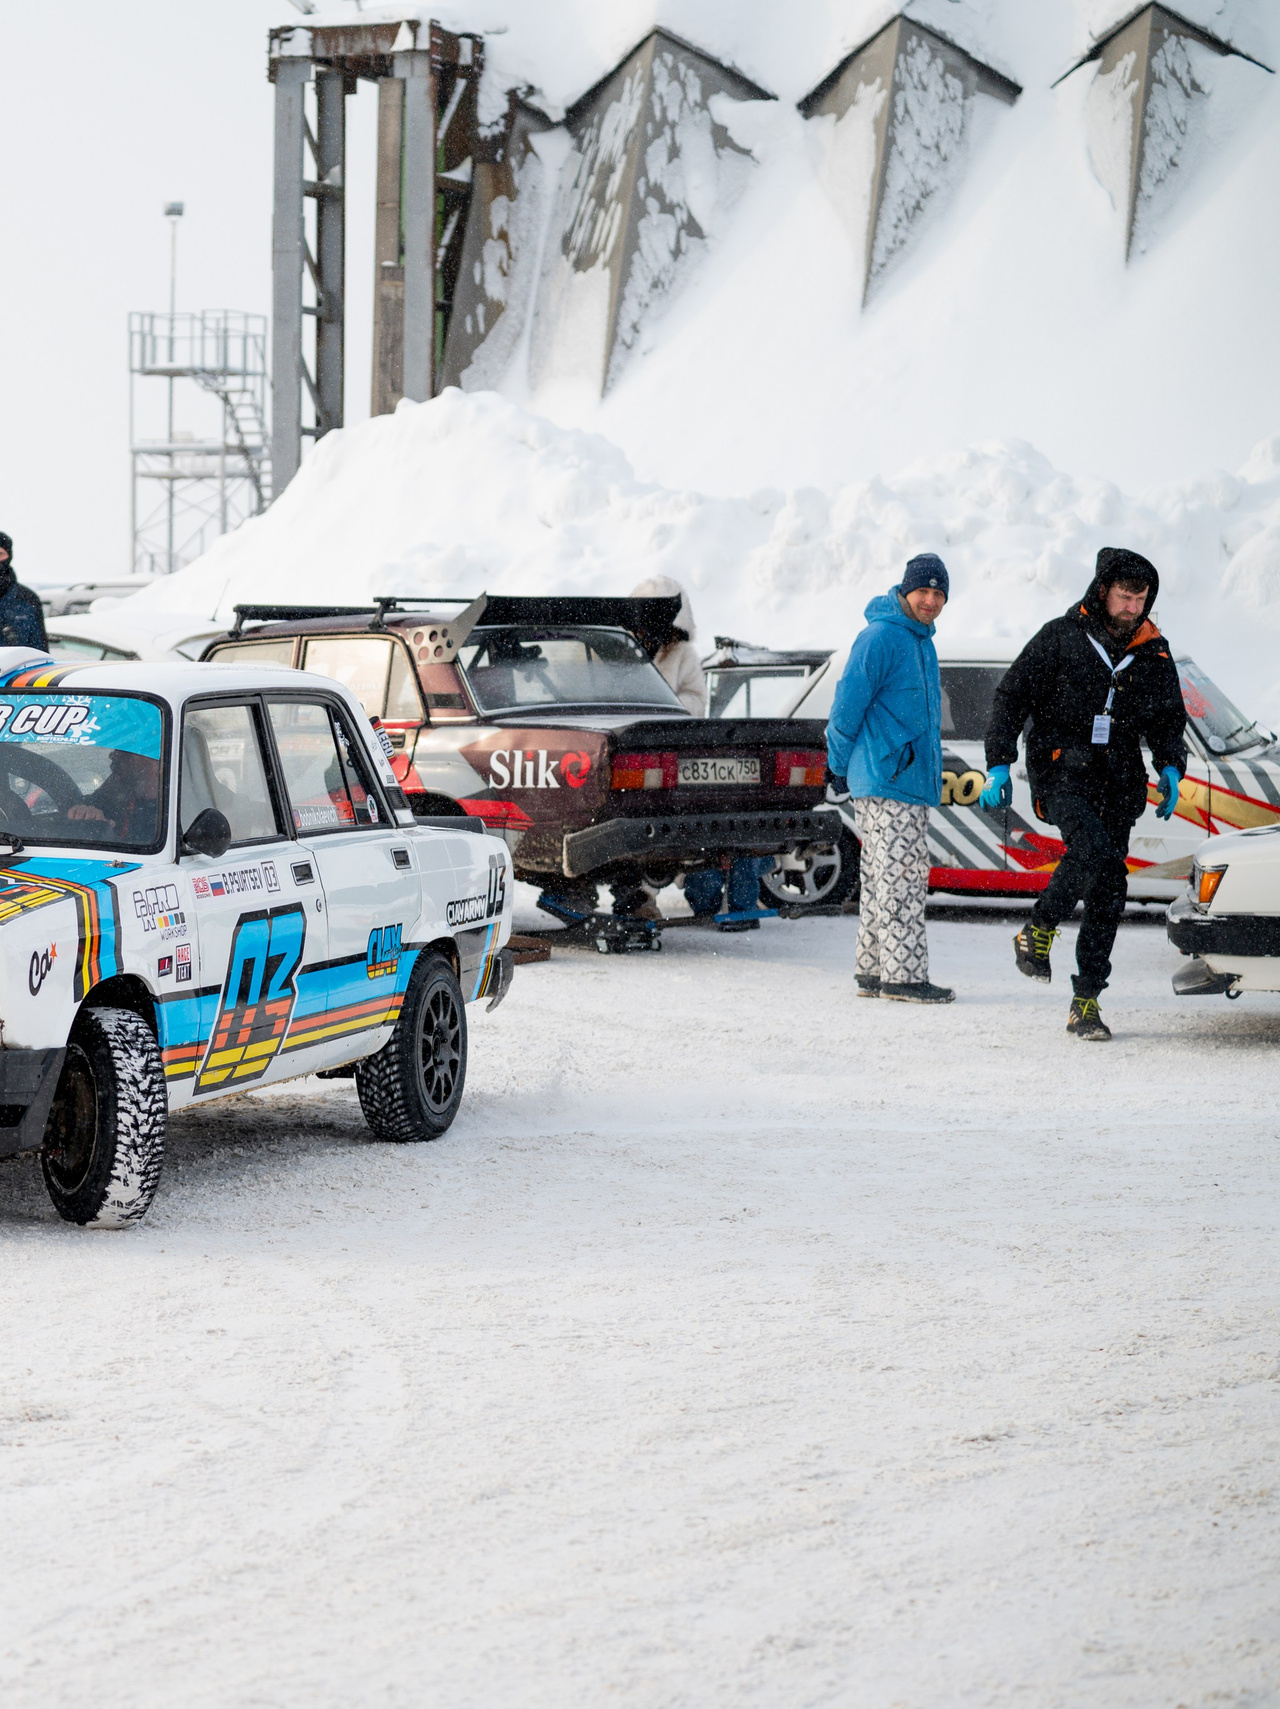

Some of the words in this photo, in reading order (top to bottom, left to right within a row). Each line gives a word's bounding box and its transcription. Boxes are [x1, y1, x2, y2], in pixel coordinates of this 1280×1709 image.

[10, 704, 90, 736] CUP
[489, 749, 561, 789] Slik
[160, 924, 187, 941] WORKSHOP
